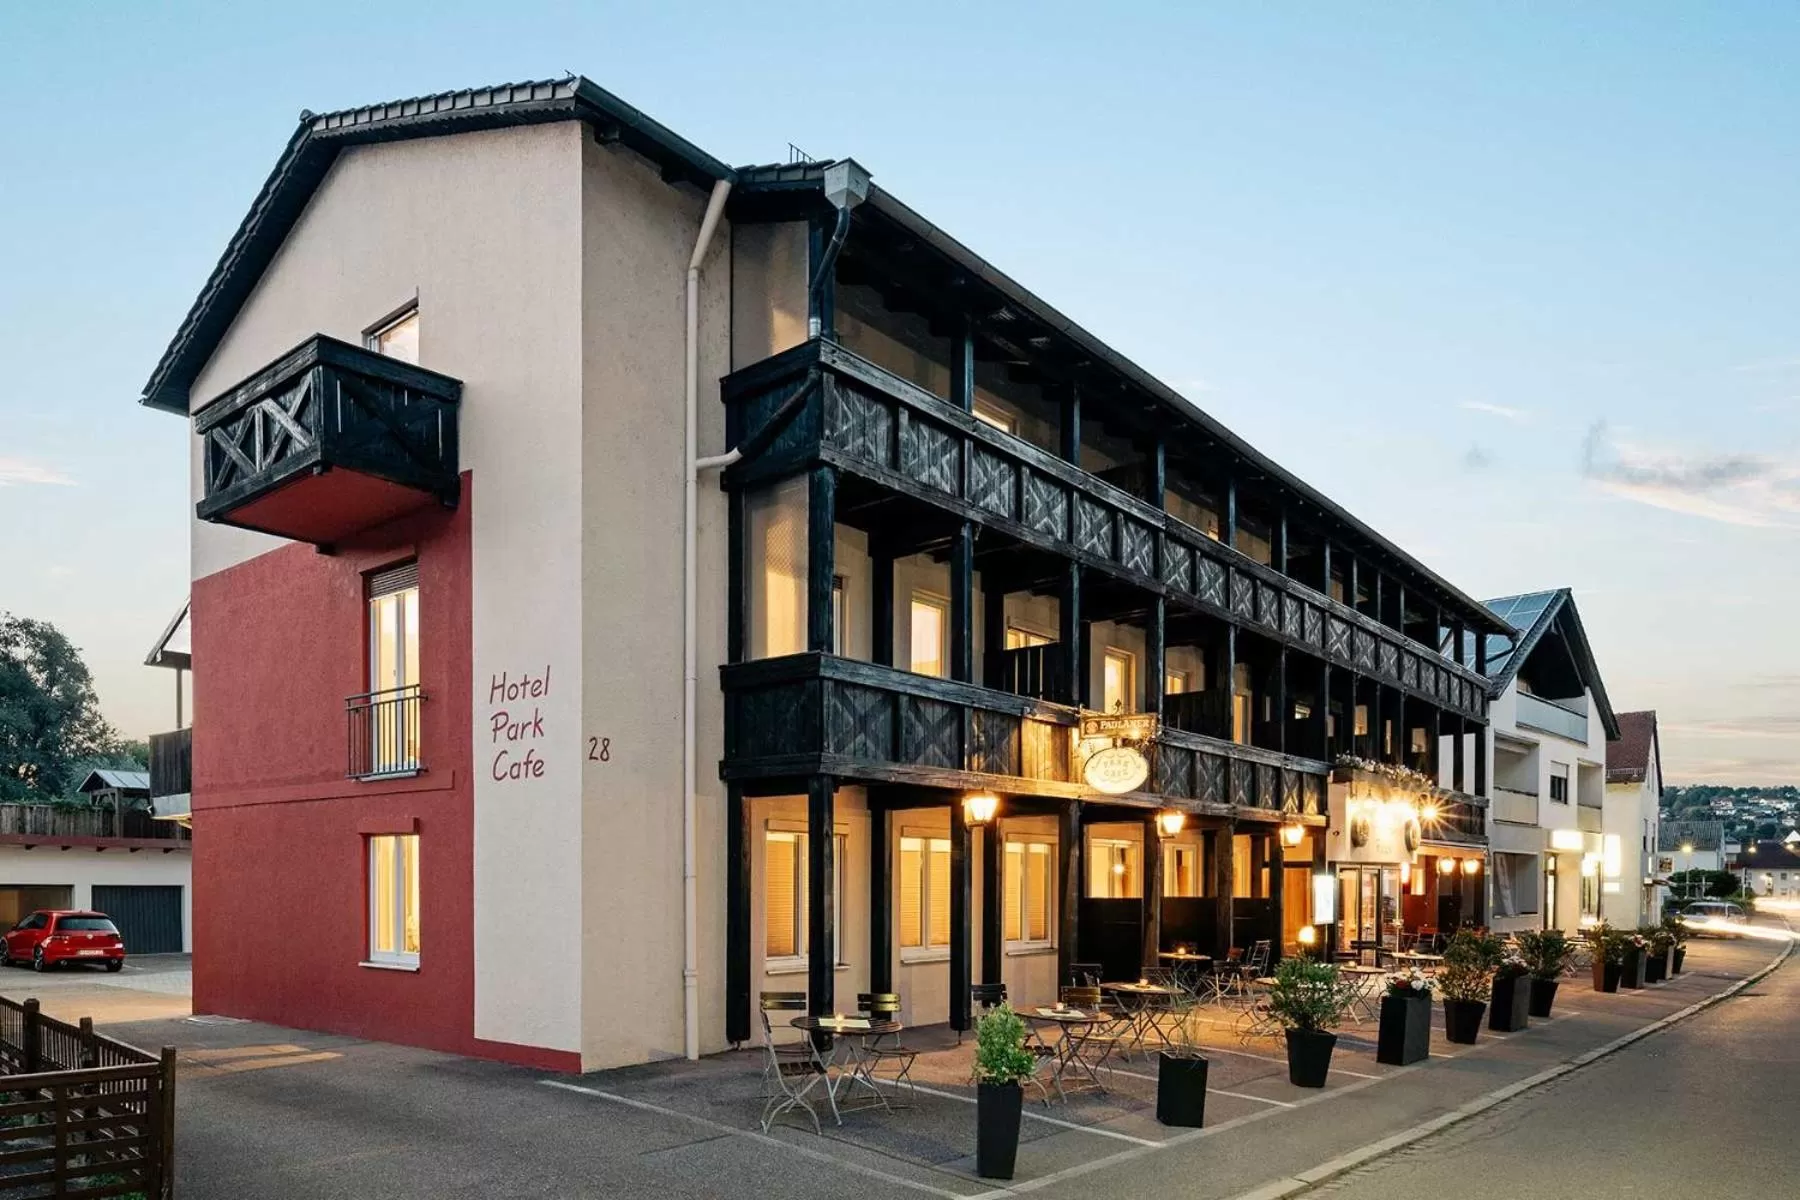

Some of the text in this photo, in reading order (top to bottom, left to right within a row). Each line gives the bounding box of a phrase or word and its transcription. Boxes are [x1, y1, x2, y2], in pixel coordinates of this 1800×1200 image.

[490, 665, 550, 704] Hotel
[490, 708, 544, 743] Park
[1100, 719, 1150, 730] PAULANER
[492, 749, 545, 781] Cafe
[588, 736, 611, 762] 28
